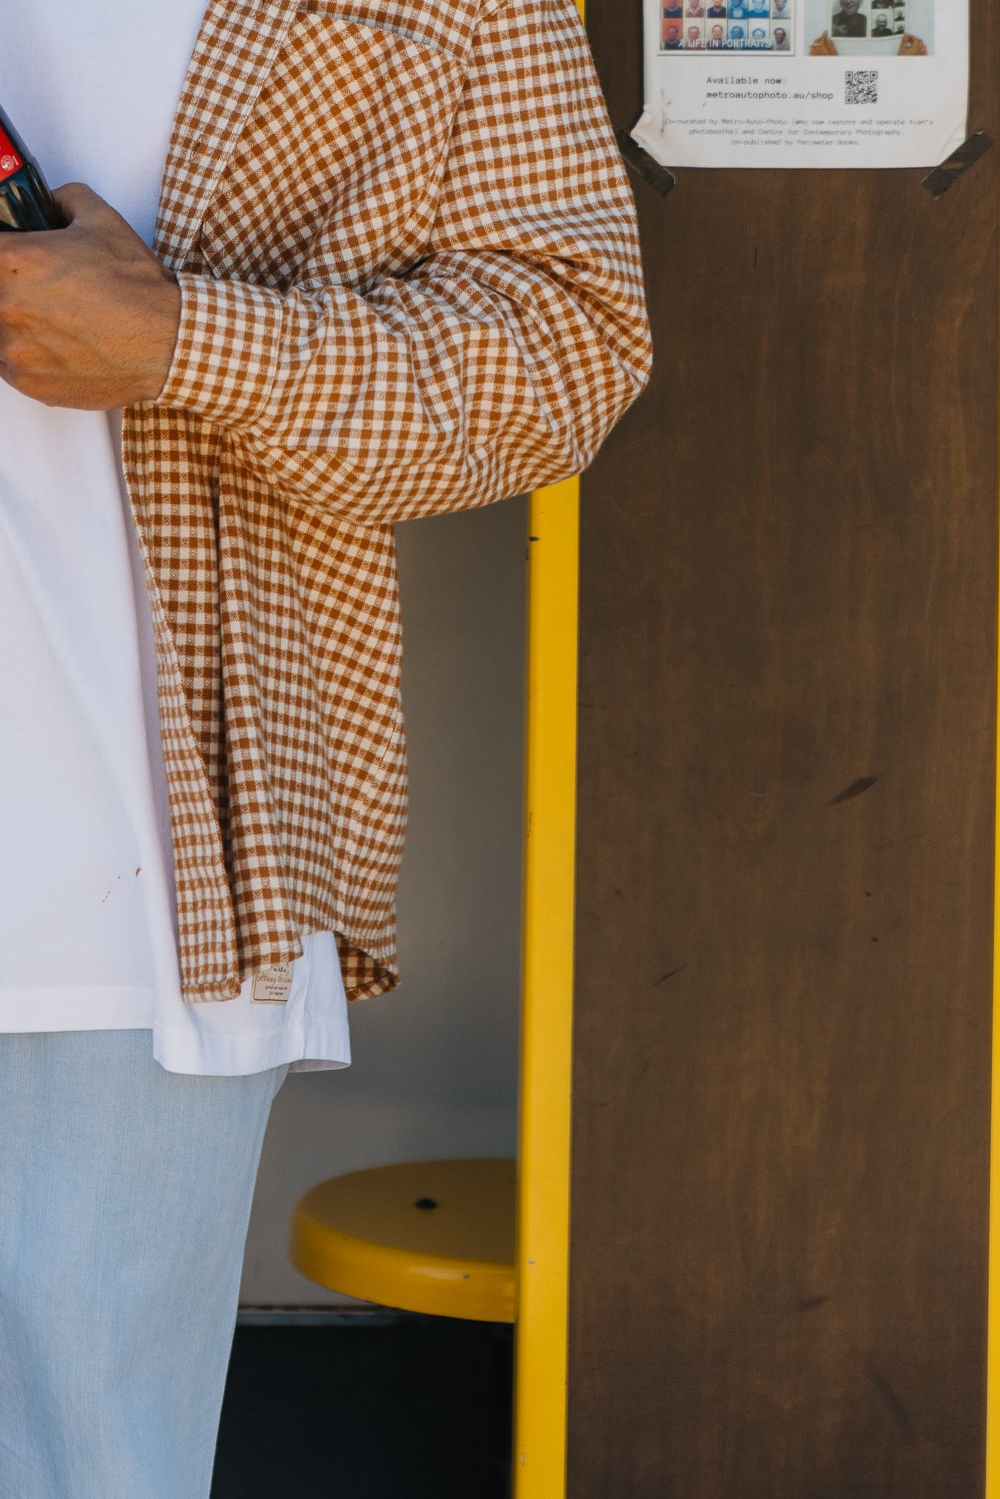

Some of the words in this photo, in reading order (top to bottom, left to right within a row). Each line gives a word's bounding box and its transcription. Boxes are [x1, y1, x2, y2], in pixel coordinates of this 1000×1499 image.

[678, 38, 686, 48] A
[688, 38, 706, 48] LIFE
[709, 38, 719, 48] IN
[721, 38, 772, 48] PORTRAITS
[706, 76, 759, 85] Available
[706, 91, 834, 101] metroautophoto.au/shop
[710, 118, 718, 127] by
[828, 118, 856, 126] restore
[860, 118, 873, 126] and
[876, 118, 905, 127] operate
[742, 128, 754, 136] and
[787, 128, 799, 136] for
[803, 128, 852, 137] Contemporary
